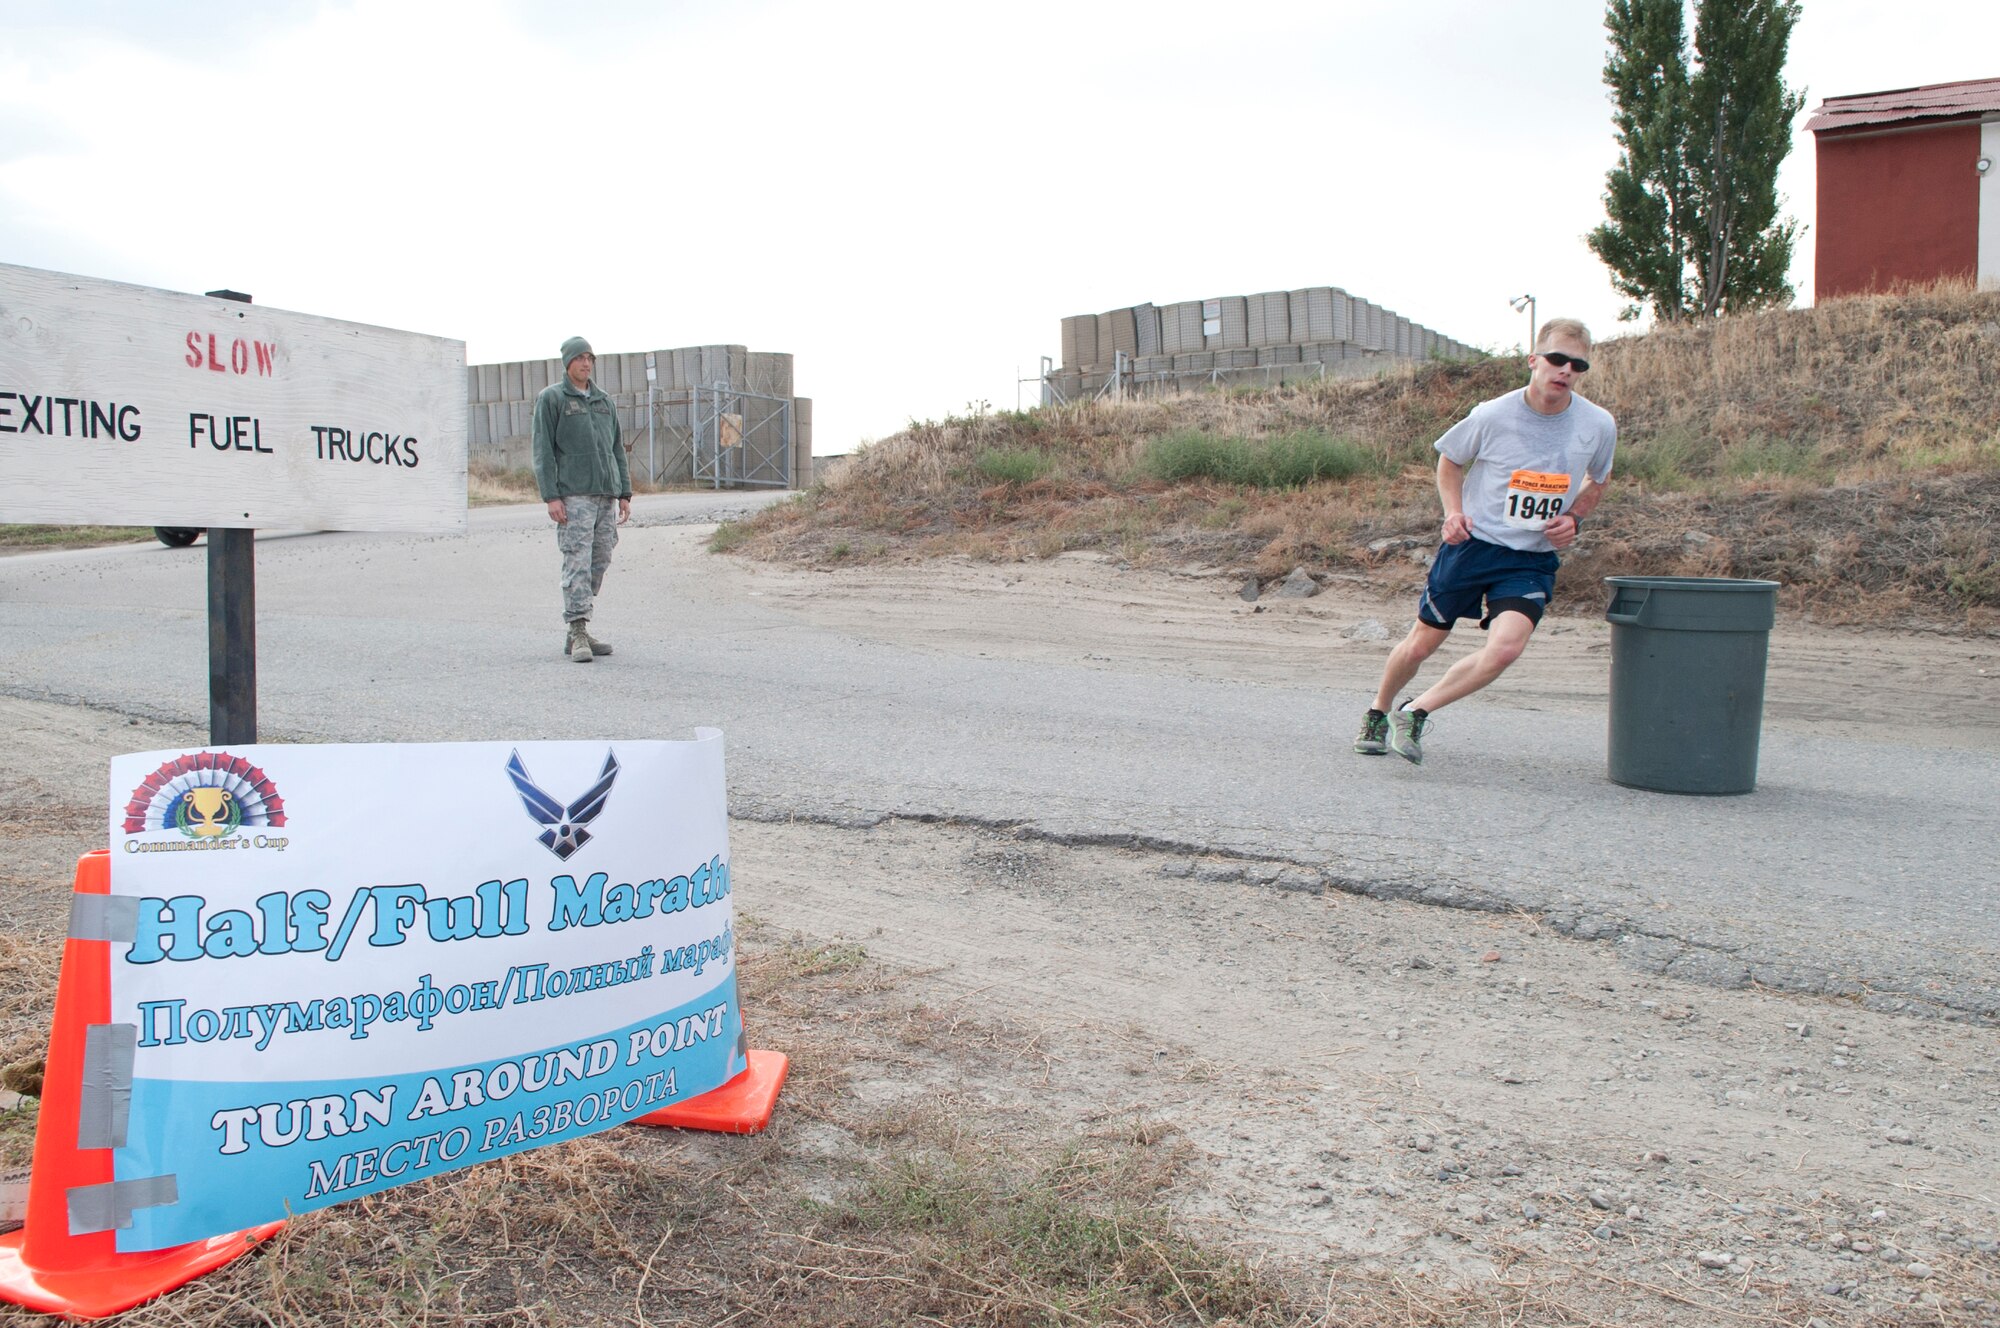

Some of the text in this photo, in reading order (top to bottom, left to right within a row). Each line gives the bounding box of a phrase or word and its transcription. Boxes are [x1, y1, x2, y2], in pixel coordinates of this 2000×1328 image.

[184, 331, 276, 378] SLOW
[0, 392, 419, 468] EXITING FUEL TRUCKS
[1508, 494, 1563, 520] 1949
[253, 834, 289, 852] Cup
[125, 877, 530, 964] Half/Full
[661, 918, 735, 977] мараф
[211, 1001, 728, 1155] TURN AROUND POINT
[304, 1066, 679, 1200] МЕСТО РАЗВОРОТА
